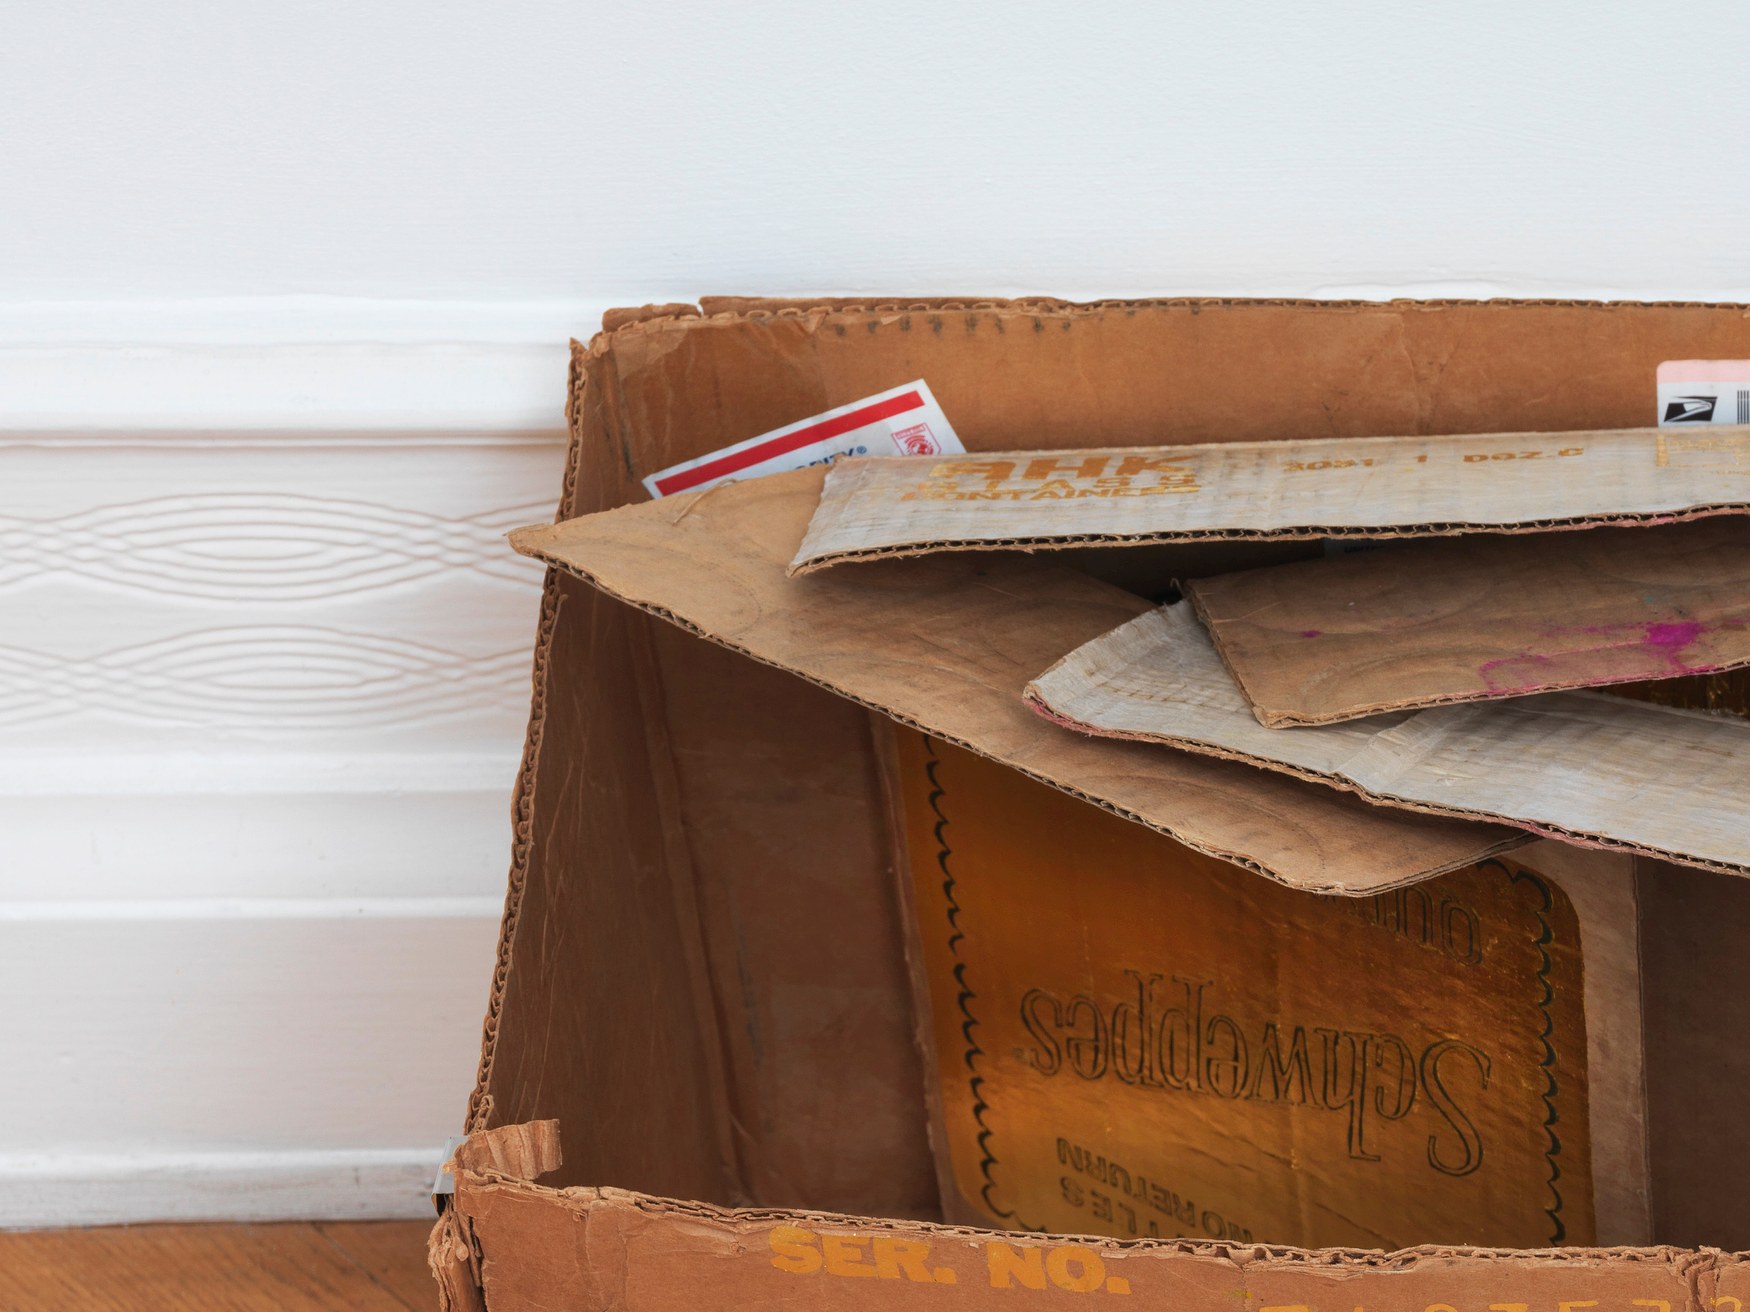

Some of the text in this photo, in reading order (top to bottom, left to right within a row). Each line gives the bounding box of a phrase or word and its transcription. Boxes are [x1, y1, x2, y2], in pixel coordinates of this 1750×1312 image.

[1019, 968, 1493, 1178] Schweppes
[1056, 1138, 1196, 1229] RETURN
[769, 1225, 1131, 1295] SER. NO.
